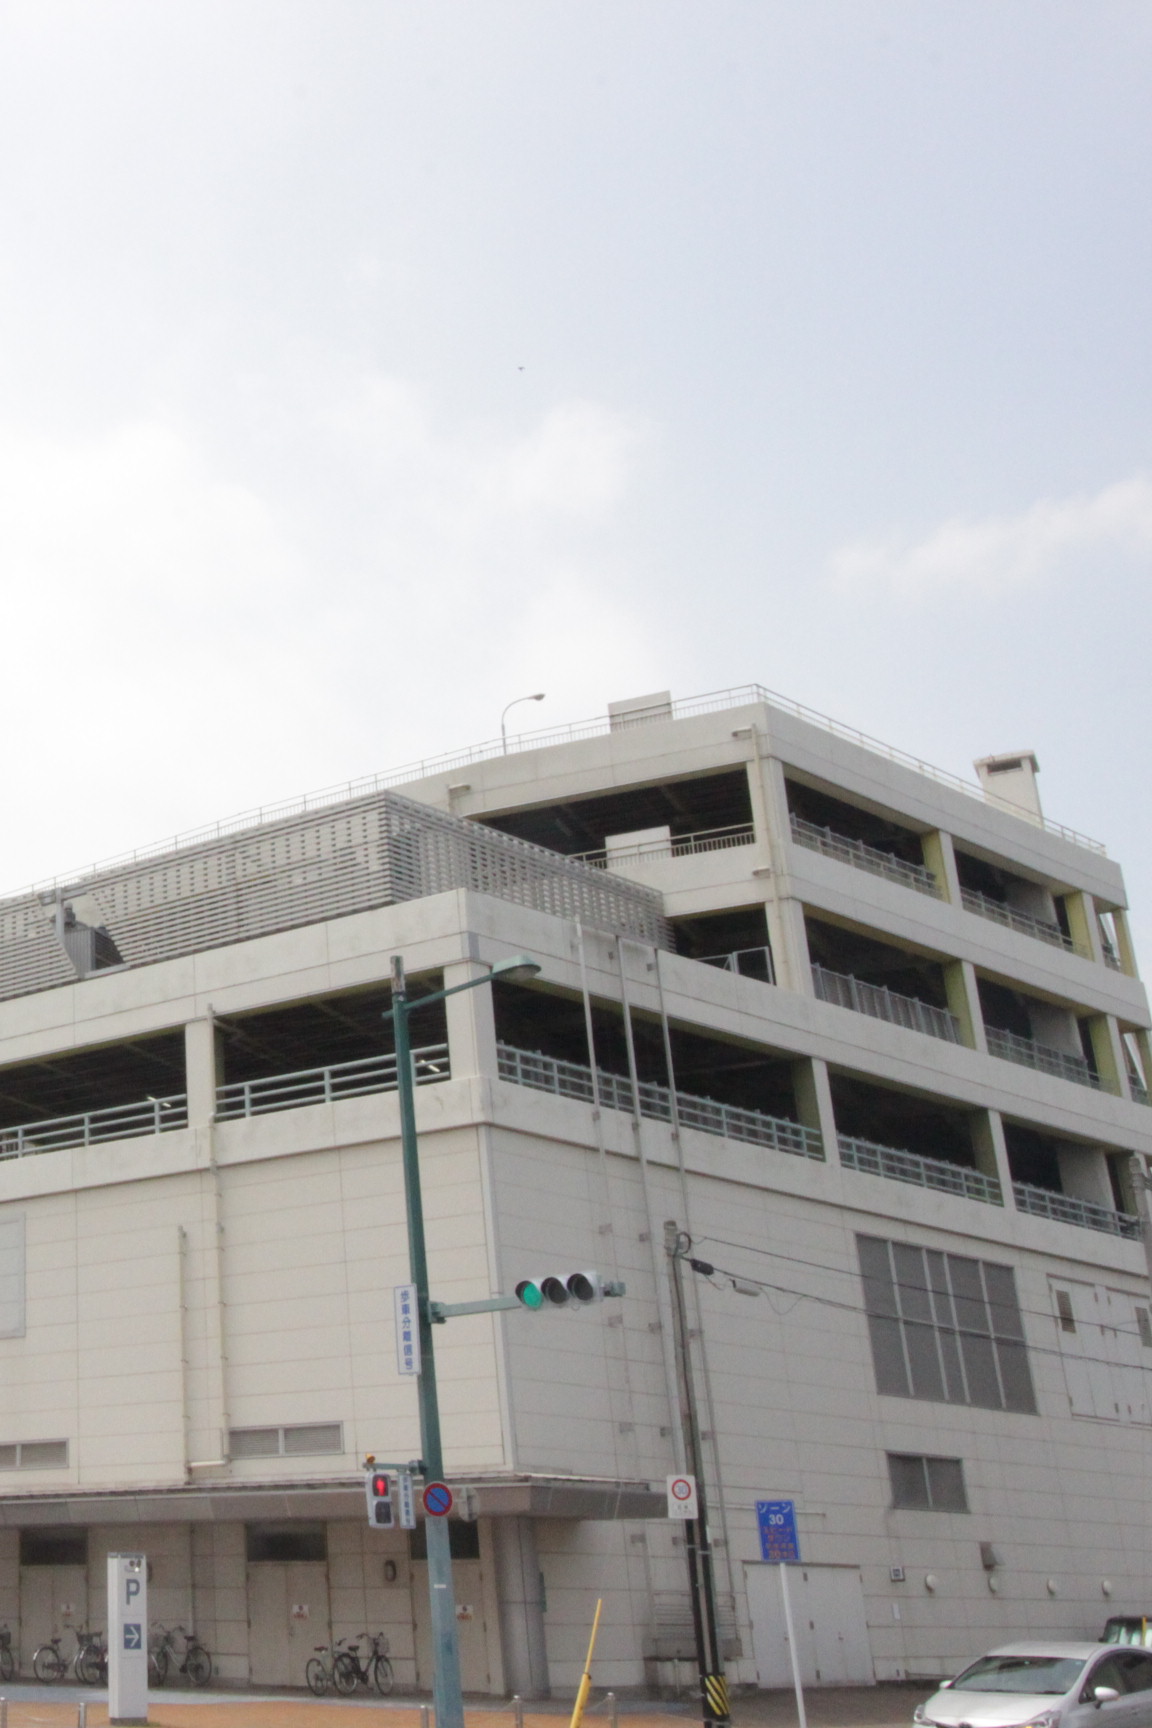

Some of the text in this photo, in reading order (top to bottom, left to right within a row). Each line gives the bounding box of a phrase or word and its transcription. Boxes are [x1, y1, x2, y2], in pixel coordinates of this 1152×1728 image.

[400, 1289, 413, 1370] 歩車分離信号
[769, 1513, 785, 1525] 30
[126, 1578, 141, 1605] P
